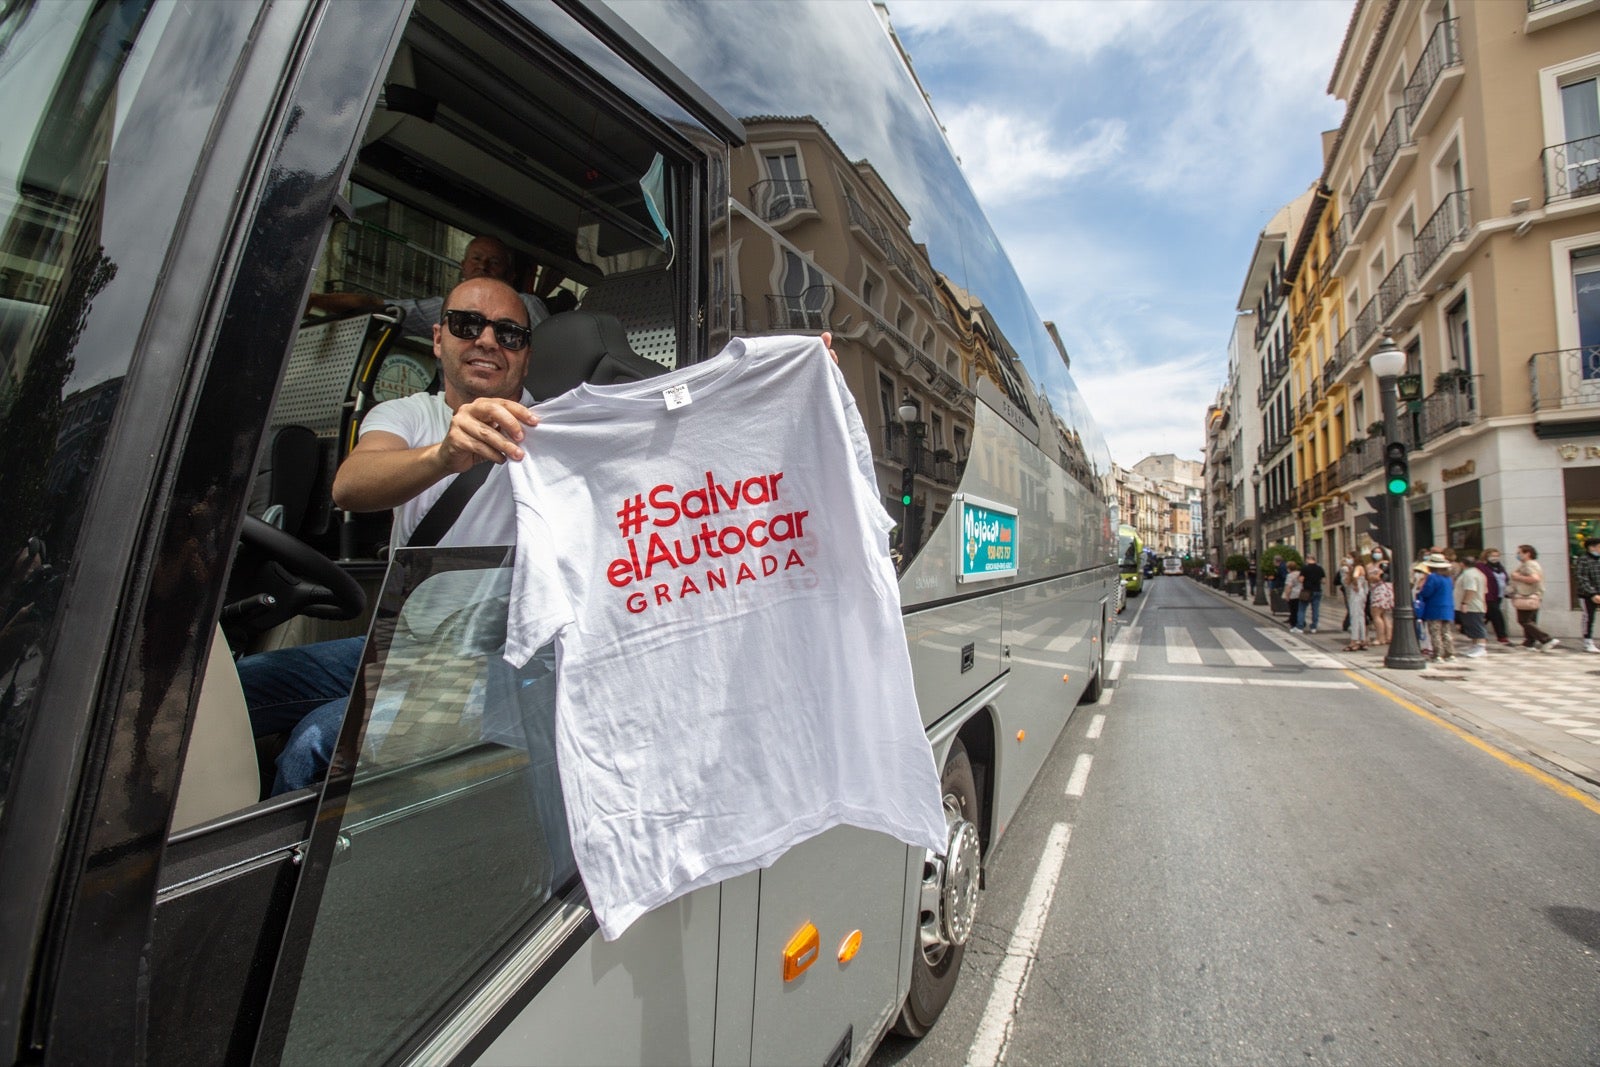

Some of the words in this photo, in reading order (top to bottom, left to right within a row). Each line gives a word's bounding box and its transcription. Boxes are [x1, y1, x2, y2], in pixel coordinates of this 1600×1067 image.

[617, 472, 784, 538] #Salvar
[607, 511, 809, 588] elAutocar
[627, 549, 805, 614] GRANADA
